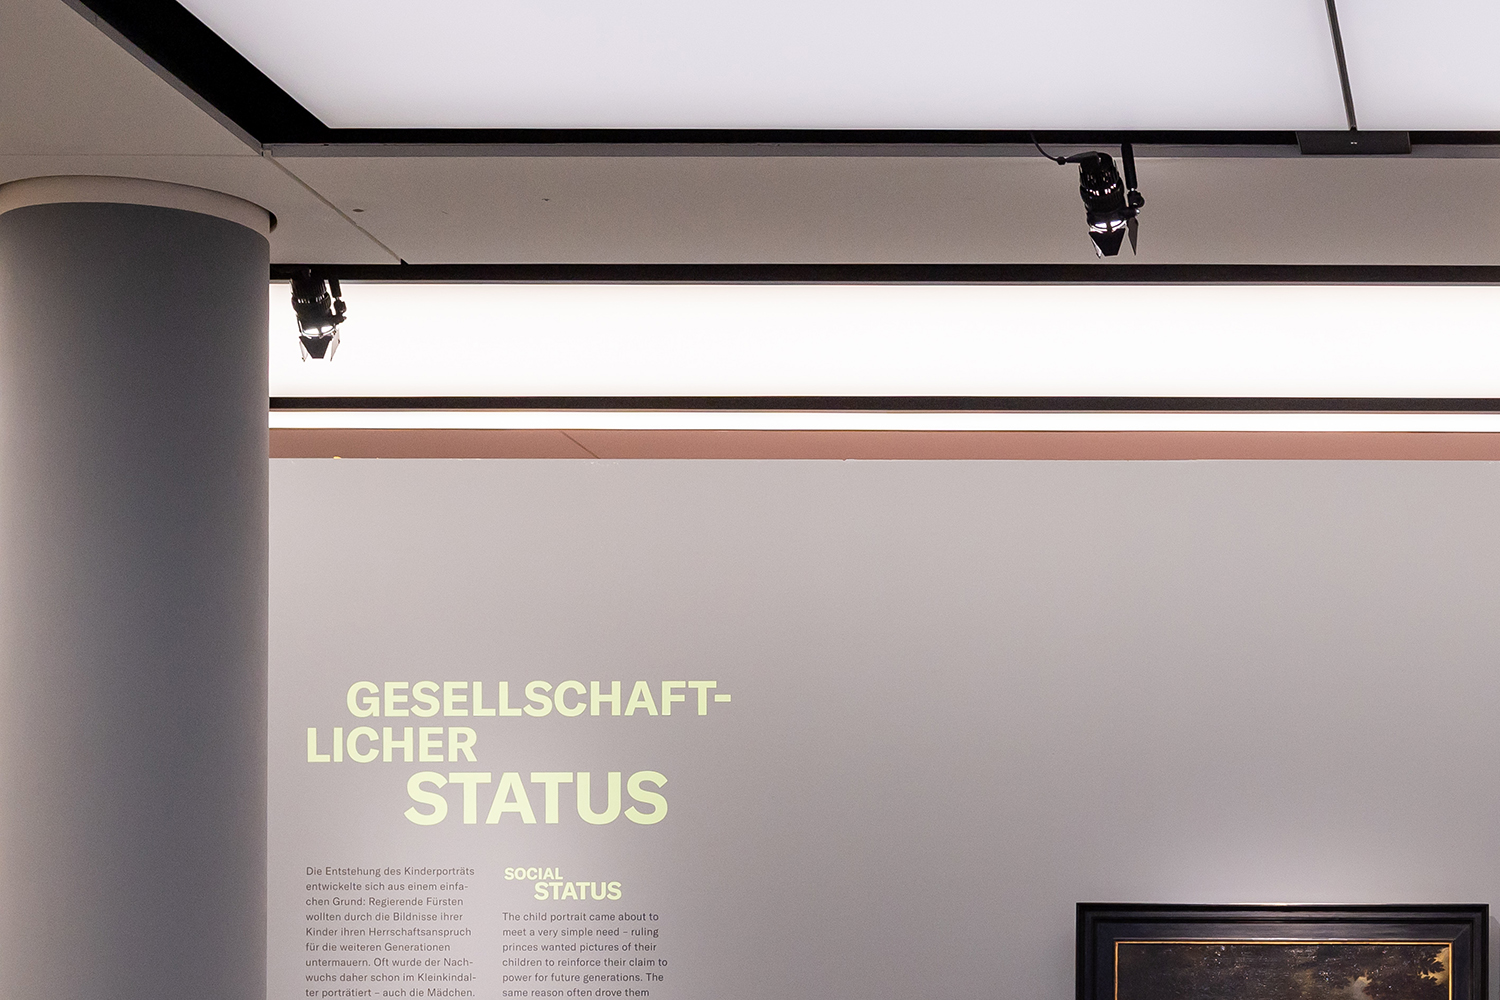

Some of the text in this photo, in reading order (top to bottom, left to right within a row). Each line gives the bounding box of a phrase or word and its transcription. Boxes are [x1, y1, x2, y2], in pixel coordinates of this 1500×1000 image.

[346, 680, 732, 717] GESELLSCHAFT-
[307, 727, 477, 763] LICHER
[404, 771, 668, 825] STATUS
[306, 866, 475, 878] Die Entstehung des Kinderporträts
[504, 867, 563, 881] SOCIAL
[305, 881, 468, 891] entwickelte sich aus einem einfa-
[533, 881, 622, 900] STATUS
[305, 896, 464, 908] chen Grund: Regierende Fürsten
[305, 912, 463, 922] wollten durch die Bildnisse ihrer
[502, 912, 659, 923] The child portrait came about to
[306, 927, 472, 938] Kinder ihren Herrschaftsanspruch
[502, 942, 657, 953] princes wanted pictures of their
[305, 972, 476, 982] wuchs daher schon im Kleinkindal-
[502, 972, 664, 984] power for future generations. The
